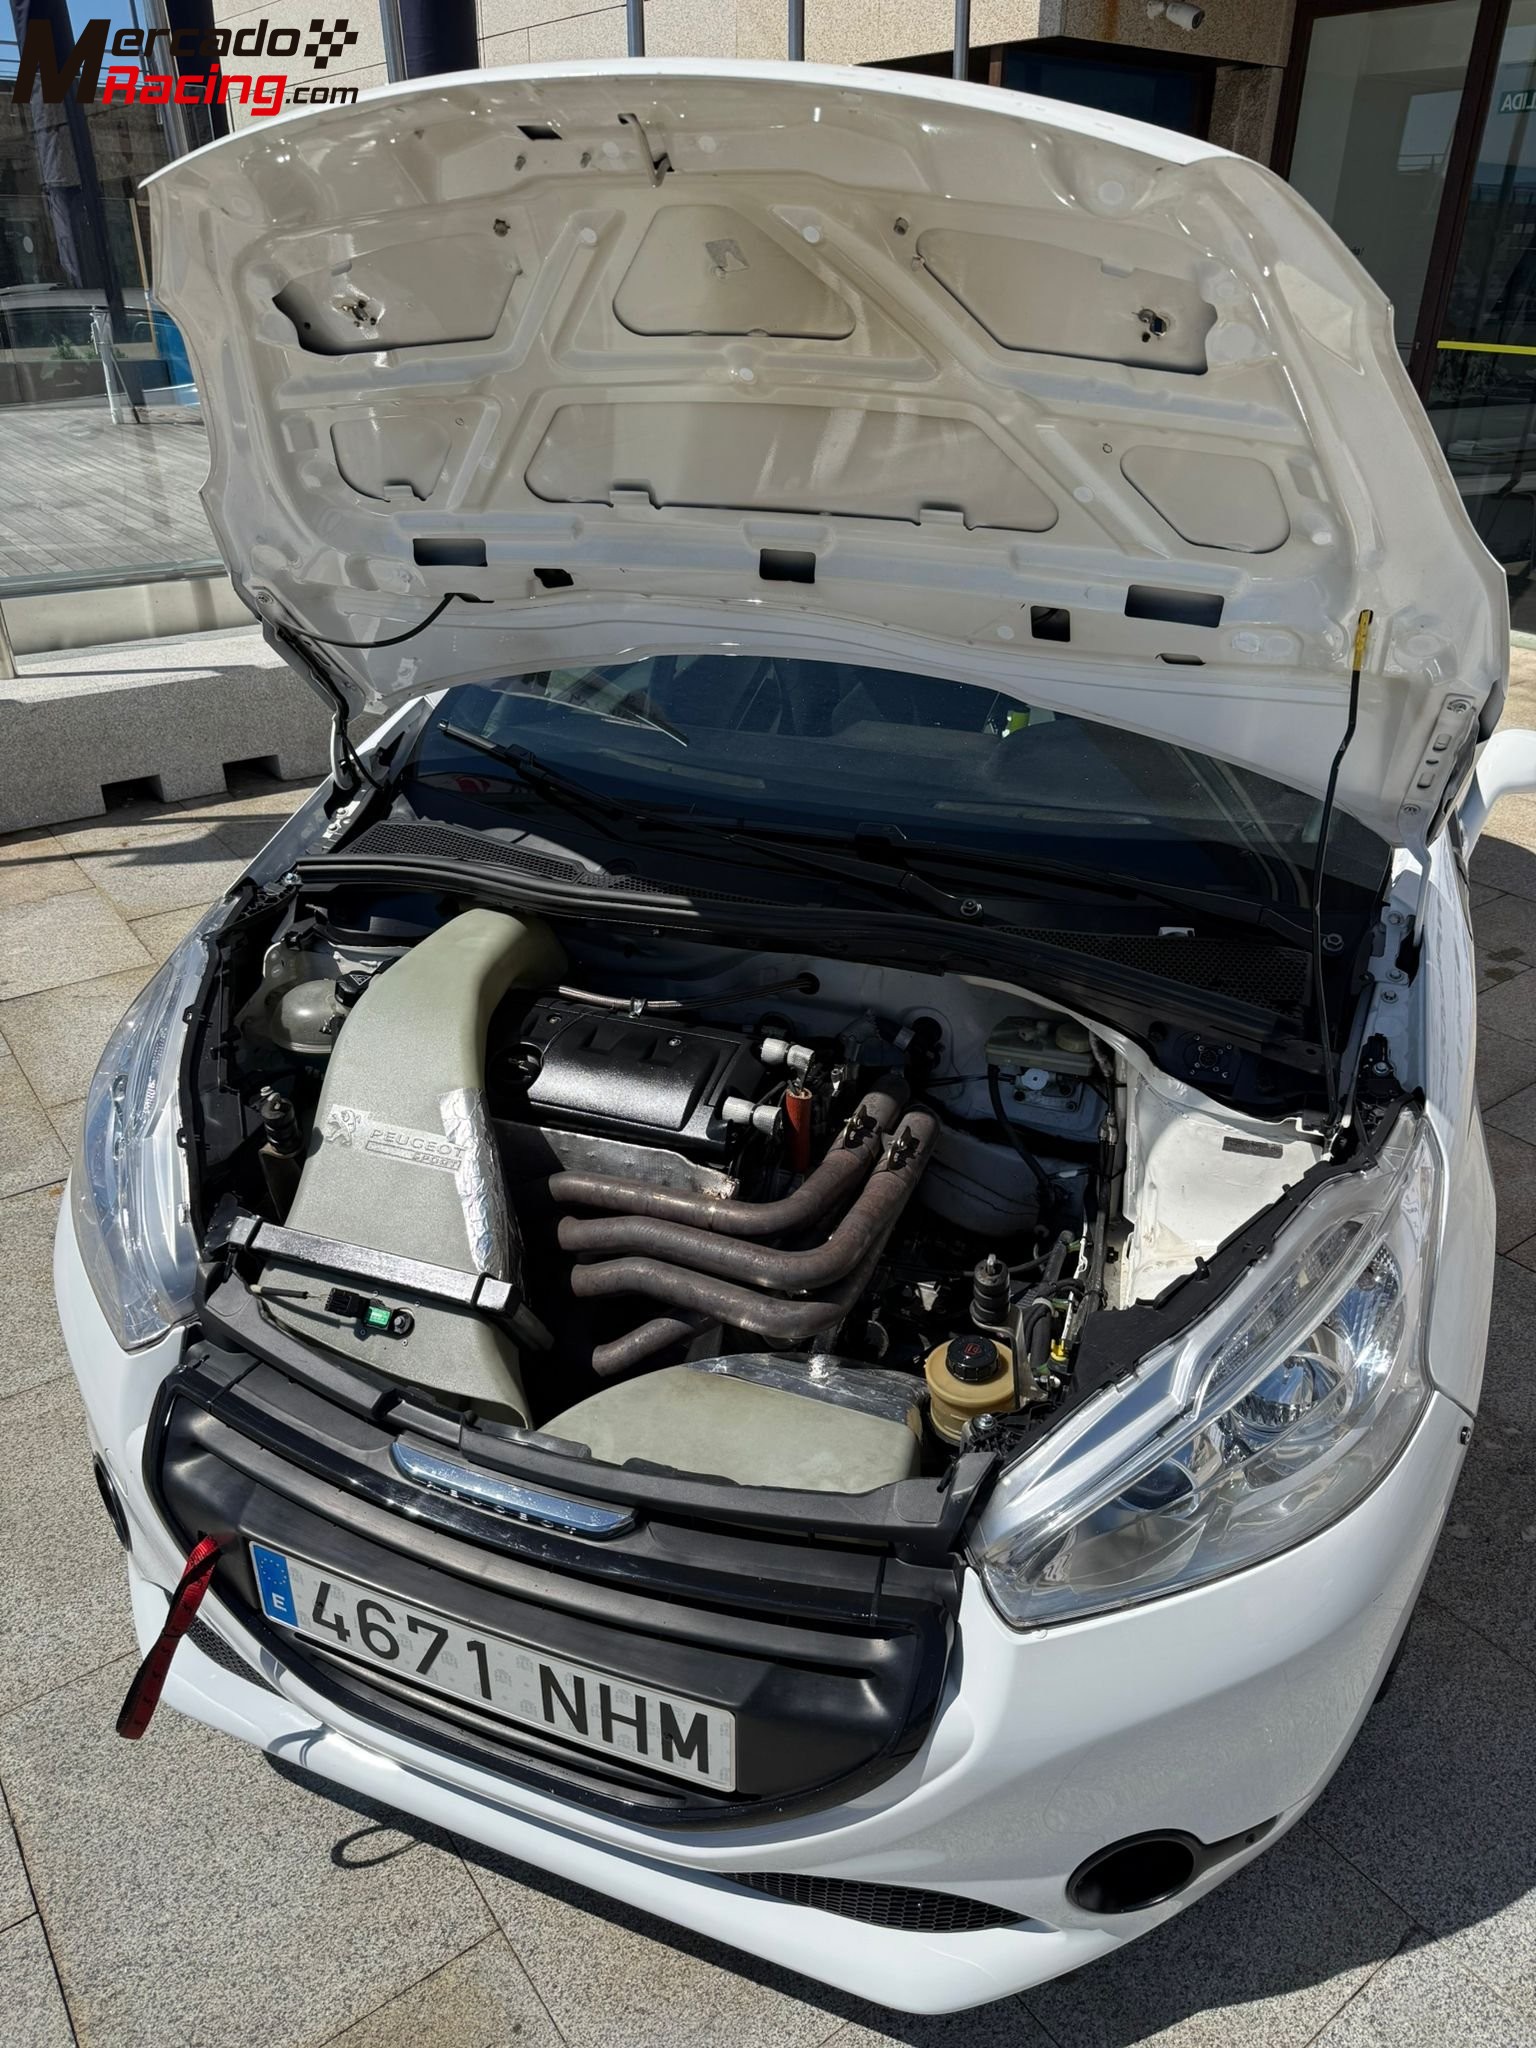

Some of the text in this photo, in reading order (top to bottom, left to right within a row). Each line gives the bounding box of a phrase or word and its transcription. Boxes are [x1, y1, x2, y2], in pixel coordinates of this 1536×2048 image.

[370, 1129, 466, 1157] PEUGEOT
[271, 1592, 287, 1612] E
[312, 1581, 492, 1701] 4671
[539, 1663, 709, 1774] NHM
